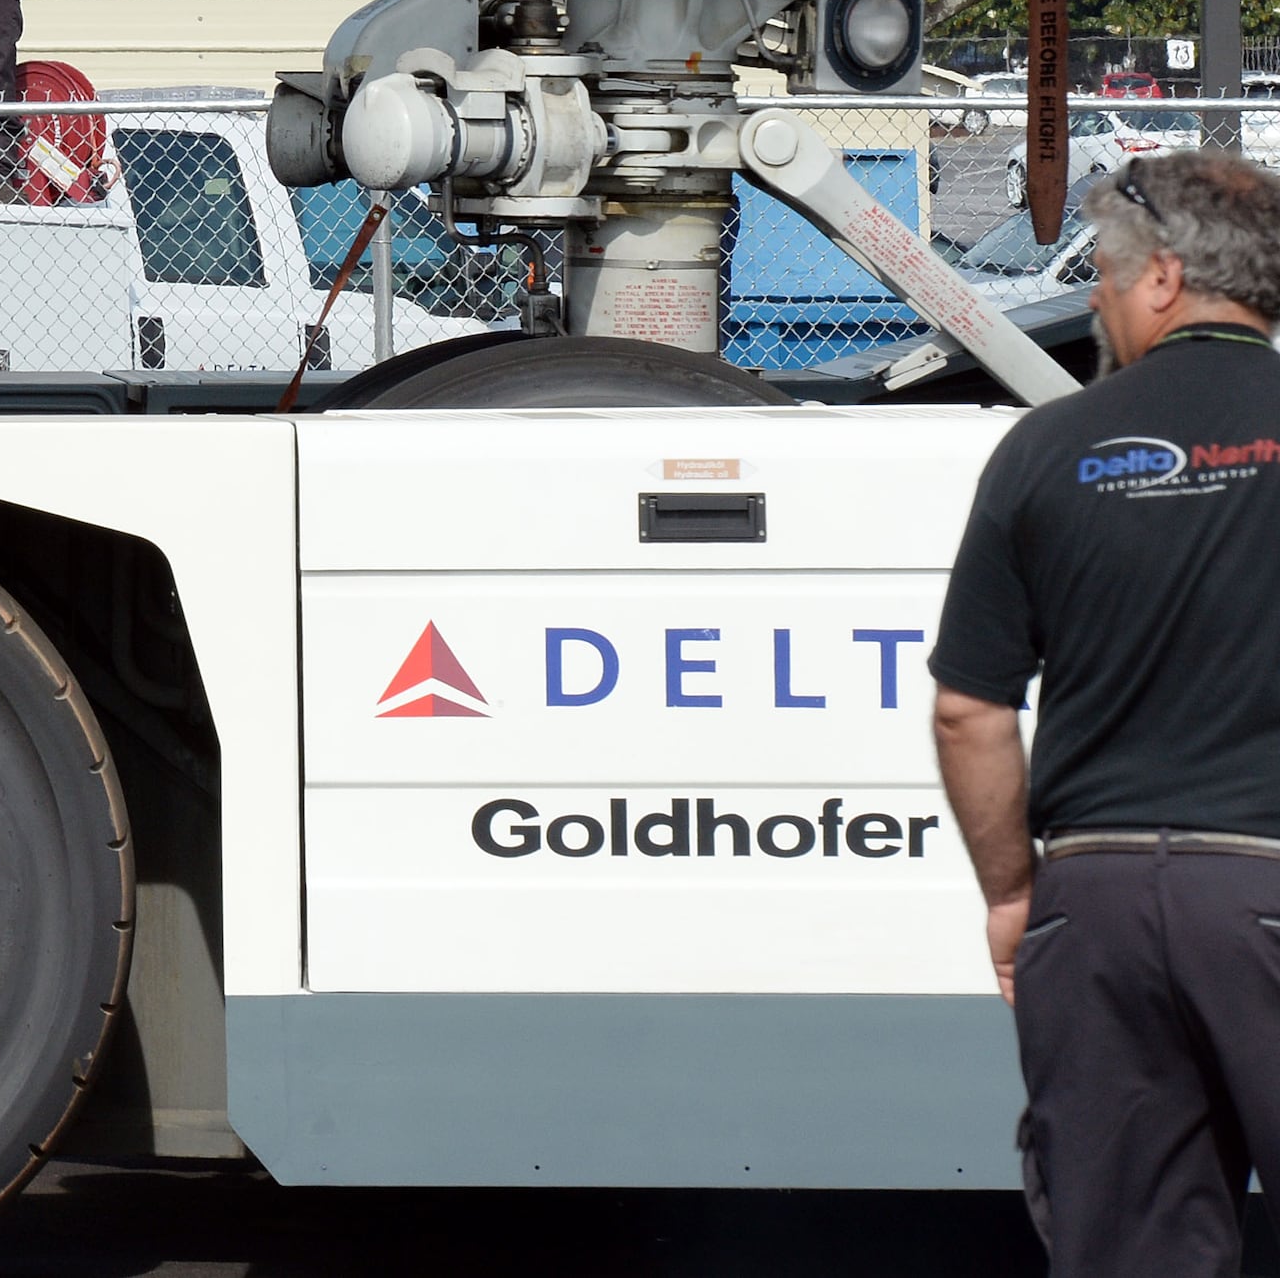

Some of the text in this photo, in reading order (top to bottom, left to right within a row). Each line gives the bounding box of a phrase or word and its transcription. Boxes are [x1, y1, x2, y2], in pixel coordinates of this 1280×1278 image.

[1040, 11, 1058, 88] BEFORE
[1039, 96, 1058, 163] FLIGHT
[1077, 448, 1174, 483] Delta
[1197, 466, 1259, 484] CENTER
[544, 627, 925, 710] DELT
[470, 797, 939, 858] Goldhofer
